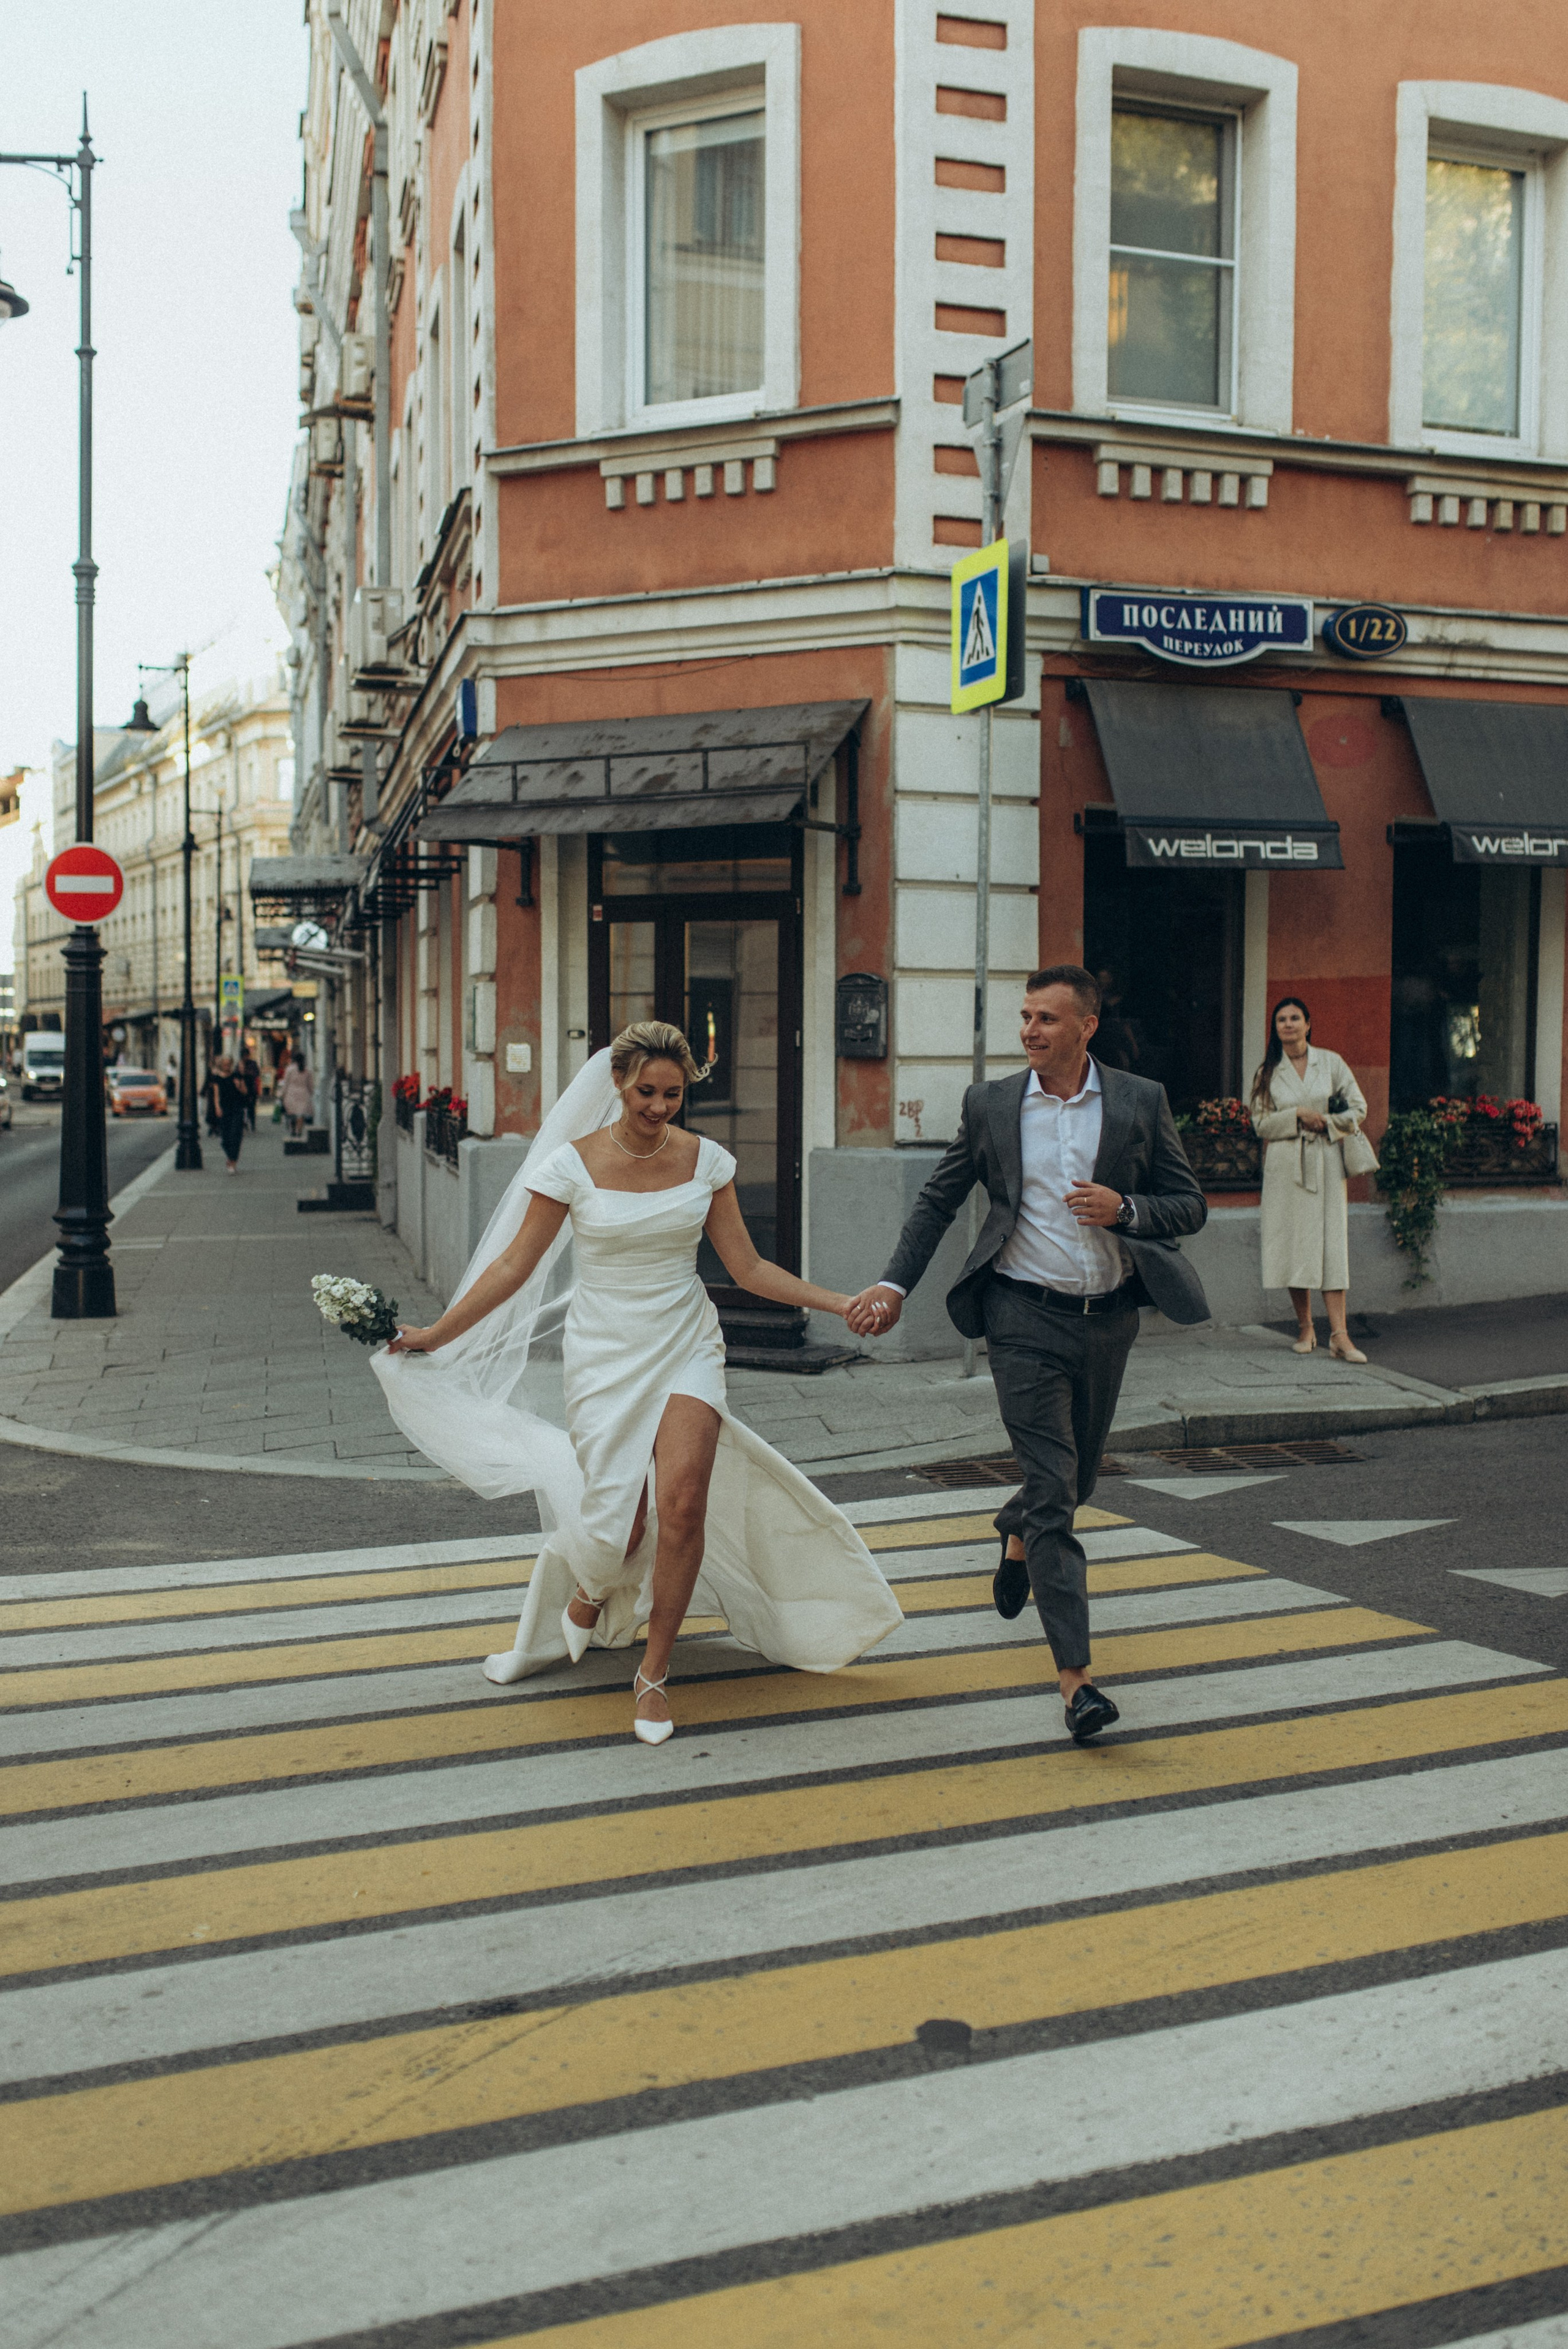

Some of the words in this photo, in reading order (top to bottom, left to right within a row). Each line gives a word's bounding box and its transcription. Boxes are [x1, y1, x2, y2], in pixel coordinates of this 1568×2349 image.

[1123, 604, 1283, 635] ПОСЛЕДНИЙ
[1349, 617, 1397, 643] 1/22
[1163, 635, 1243, 657] ПЕРЕУЛОК
[1148, 833, 1318, 860] welonda
